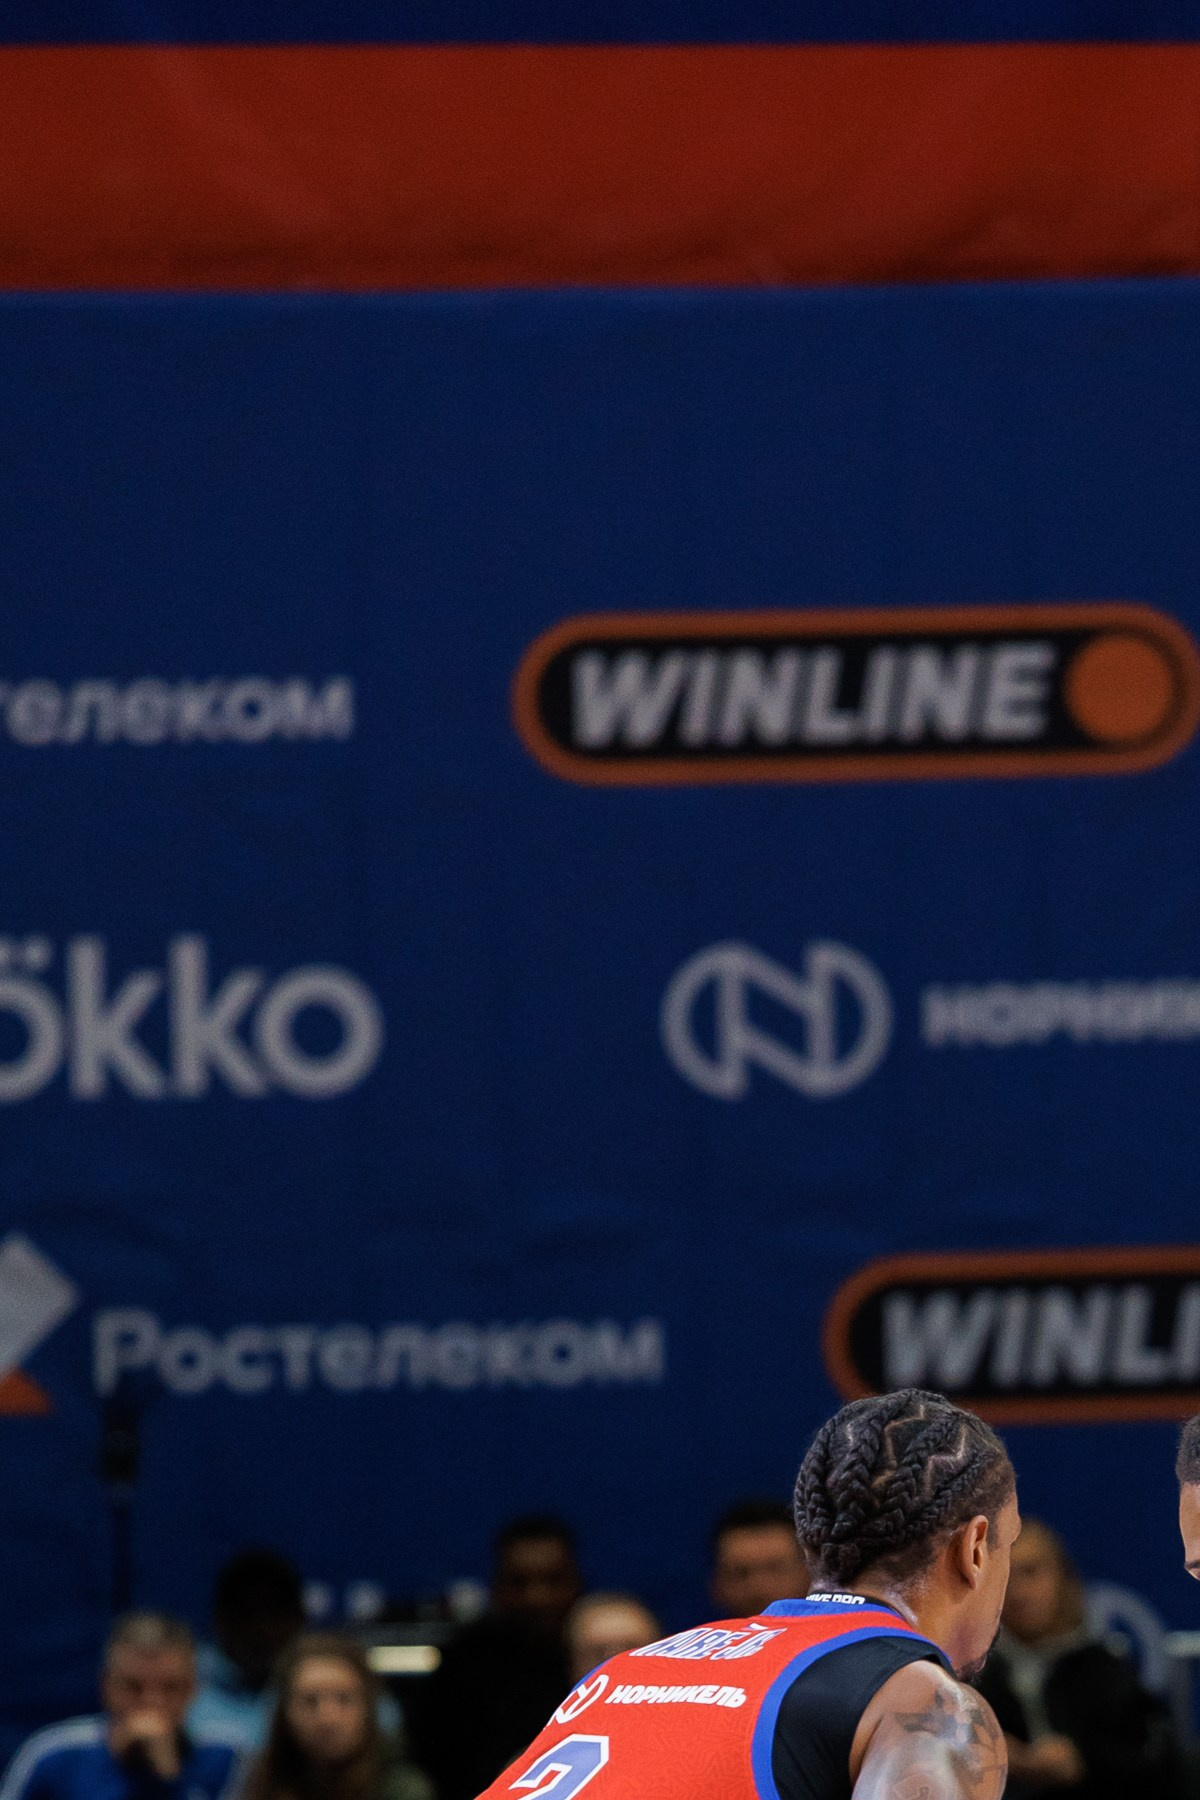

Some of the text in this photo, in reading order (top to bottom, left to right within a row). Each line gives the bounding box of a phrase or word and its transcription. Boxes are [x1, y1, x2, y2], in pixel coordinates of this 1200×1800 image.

[0, 676, 352, 744] елеком
[569, 641, 1060, 749] WINLINE
[93, 1307, 664, 1396] Ростелеком
[604, 1684, 747, 1708] НОРНИКЕЛЬ
